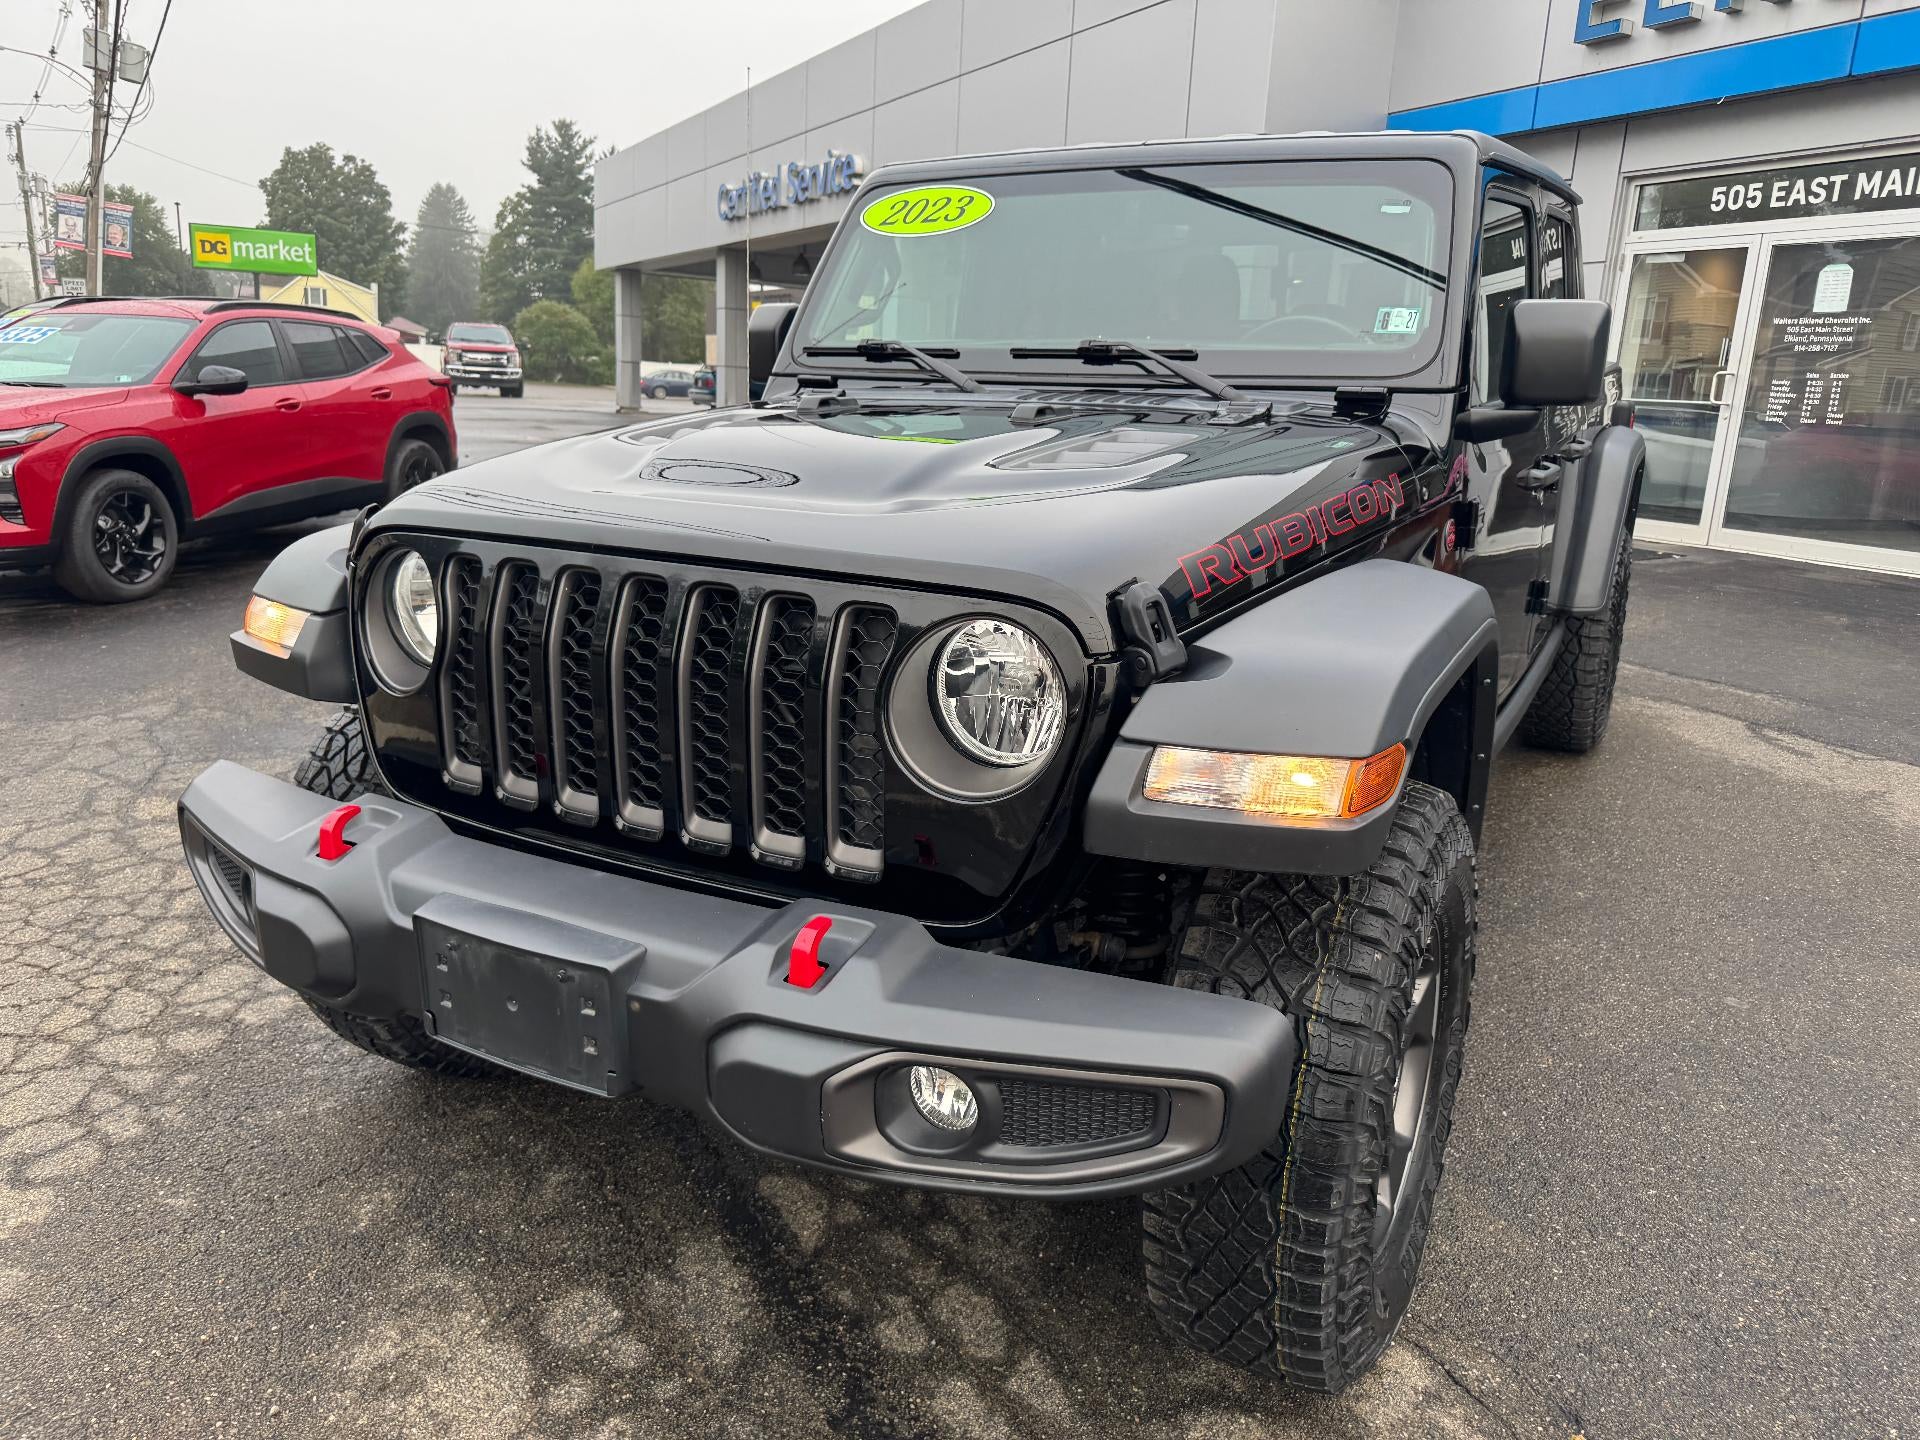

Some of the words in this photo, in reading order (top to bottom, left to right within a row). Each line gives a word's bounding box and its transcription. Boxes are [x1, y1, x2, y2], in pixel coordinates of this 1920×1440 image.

[717, 164, 787, 222] Certified
[786, 149, 865, 204] Service
[1710, 182, 1763, 212] 505
[1769, 174, 1849, 208] EAST
[1854, 167, 1920, 200] MAI
[878, 195, 975, 226] 2023
[199, 239, 228, 255] DG
[233, 239, 313, 264] market
[1773, 317, 1798, 325] Walters
[1798, 317, 1824, 325] Elkland
[1824, 316, 1859, 325] Chevrolet
[1858, 316, 1872, 324] Inc.
[1809, 335, 1854, 344] Pennsylvania
[1177, 473, 1405, 598] RUBICON
